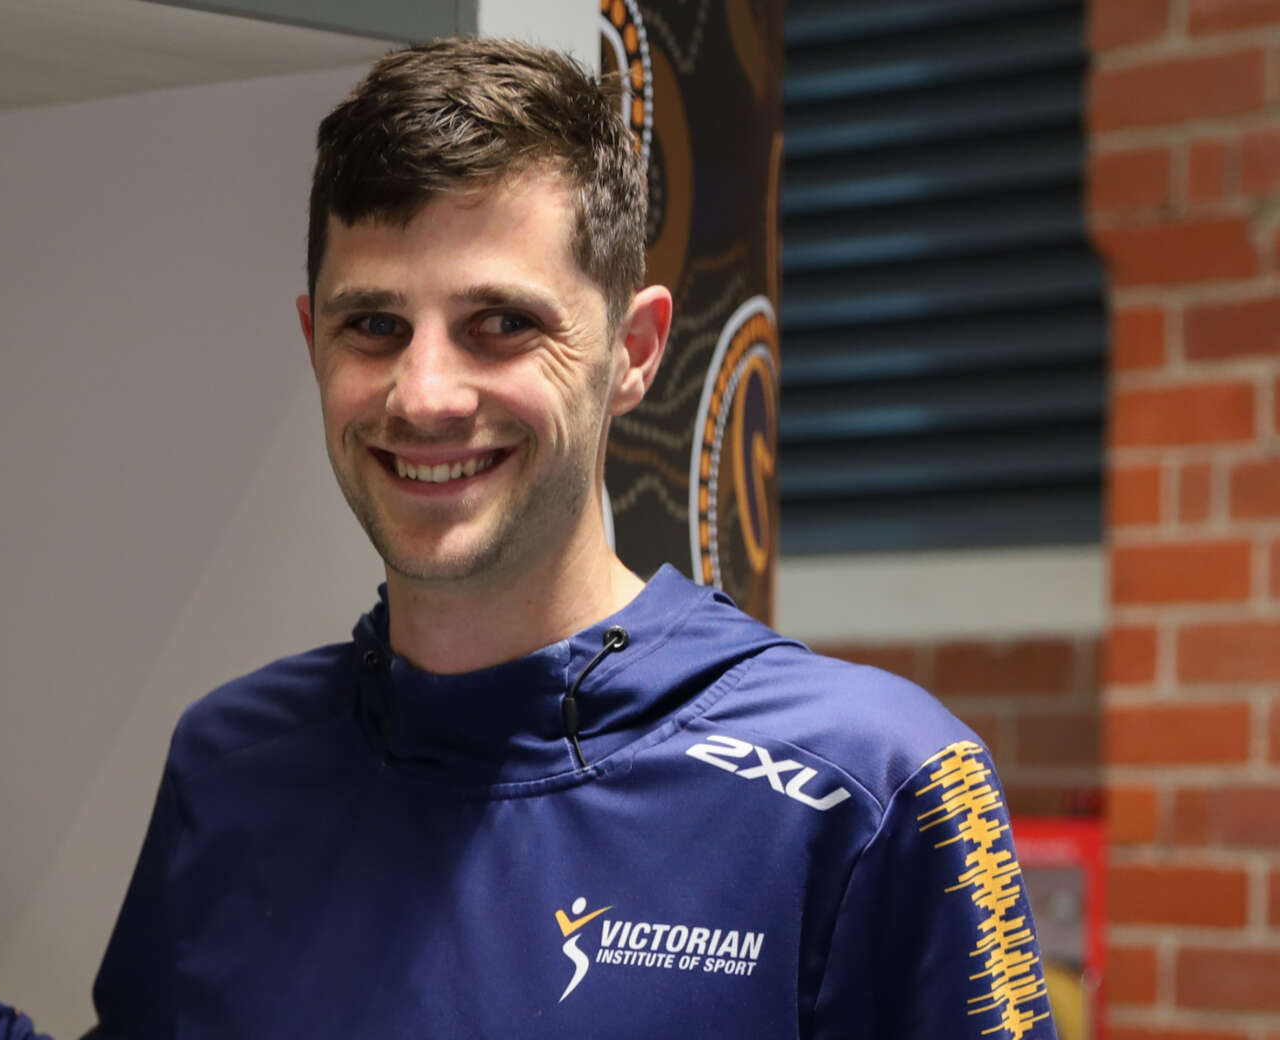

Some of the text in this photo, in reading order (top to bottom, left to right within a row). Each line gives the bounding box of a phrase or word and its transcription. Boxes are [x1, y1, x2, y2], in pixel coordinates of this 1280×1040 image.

[685, 735, 851, 811] 2XU
[600, 920, 765, 960] VICTORIAN
[596, 948, 757, 976] INSTITUTE OF SPORT
